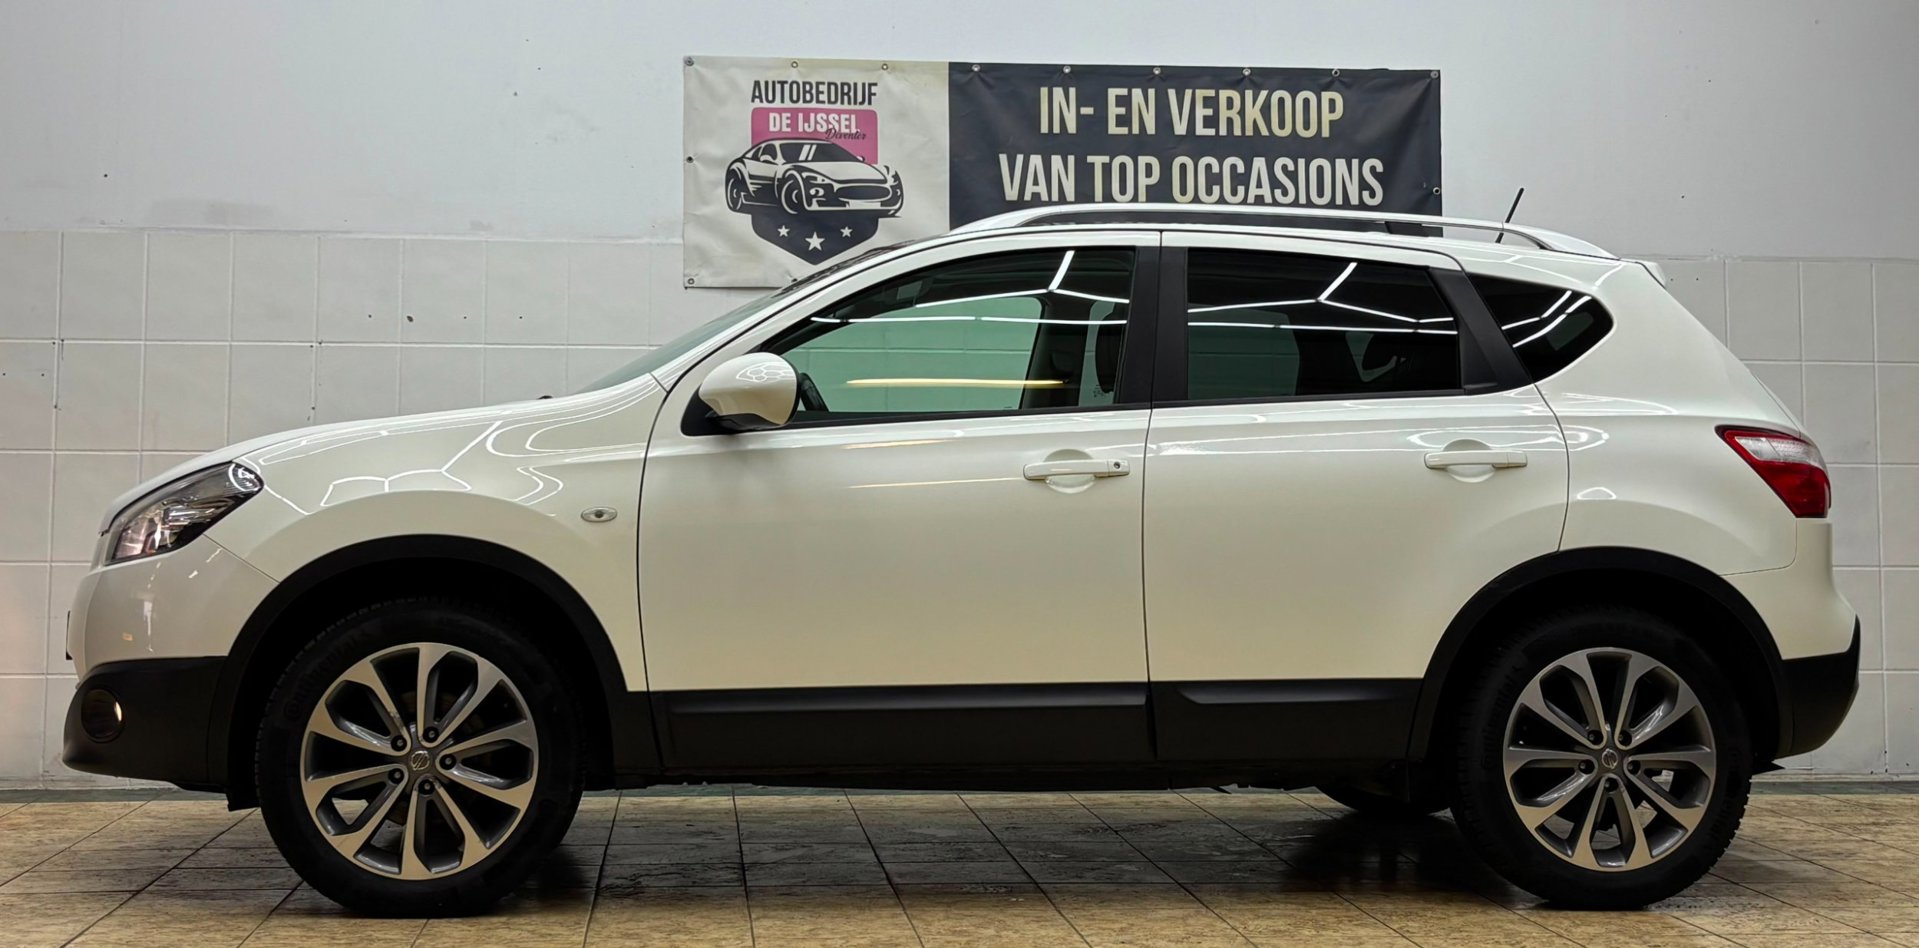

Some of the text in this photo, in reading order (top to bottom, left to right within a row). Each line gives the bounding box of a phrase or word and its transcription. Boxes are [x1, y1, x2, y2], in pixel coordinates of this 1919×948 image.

[751, 80, 878, 105] AUTOBEDRIJF
[768, 112, 861, 134] DE IJSSEL
[1040, 87, 1344, 138] IN- EN VERKOOP
[999, 154, 1384, 206] VAN TOP OCCASIONS
